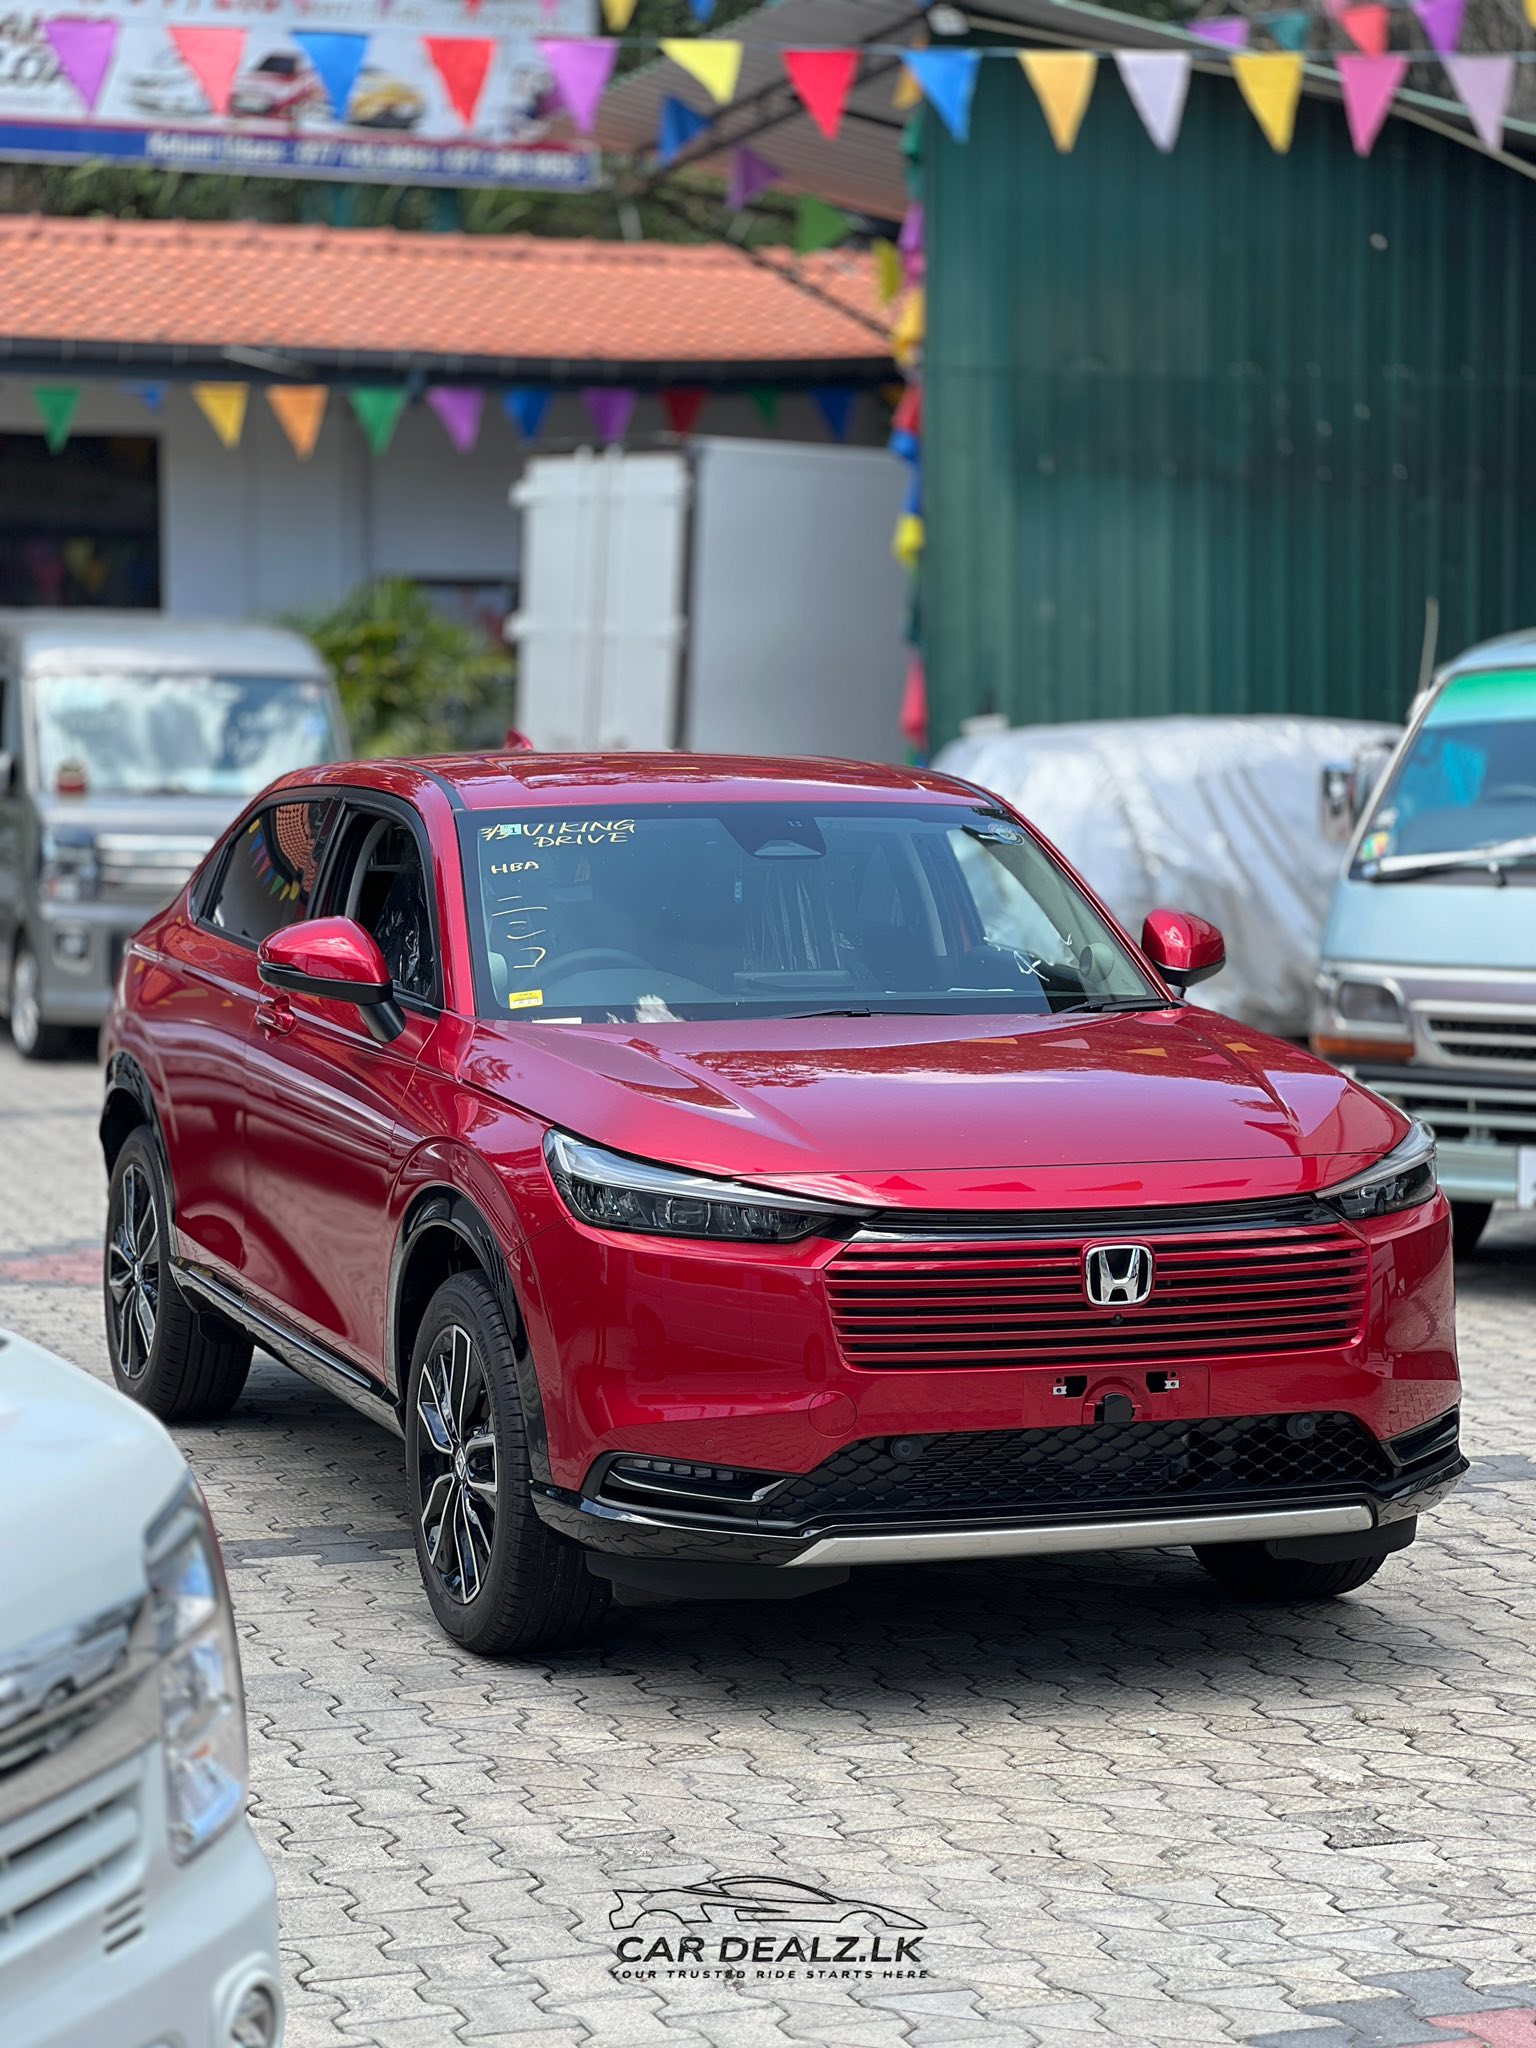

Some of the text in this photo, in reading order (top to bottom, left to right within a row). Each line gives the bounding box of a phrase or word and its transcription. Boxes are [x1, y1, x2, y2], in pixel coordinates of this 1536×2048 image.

[523, 819, 635, 836] VIKING
[533, 832, 629, 848] DRIVE
[491, 861, 539, 874] HBA
